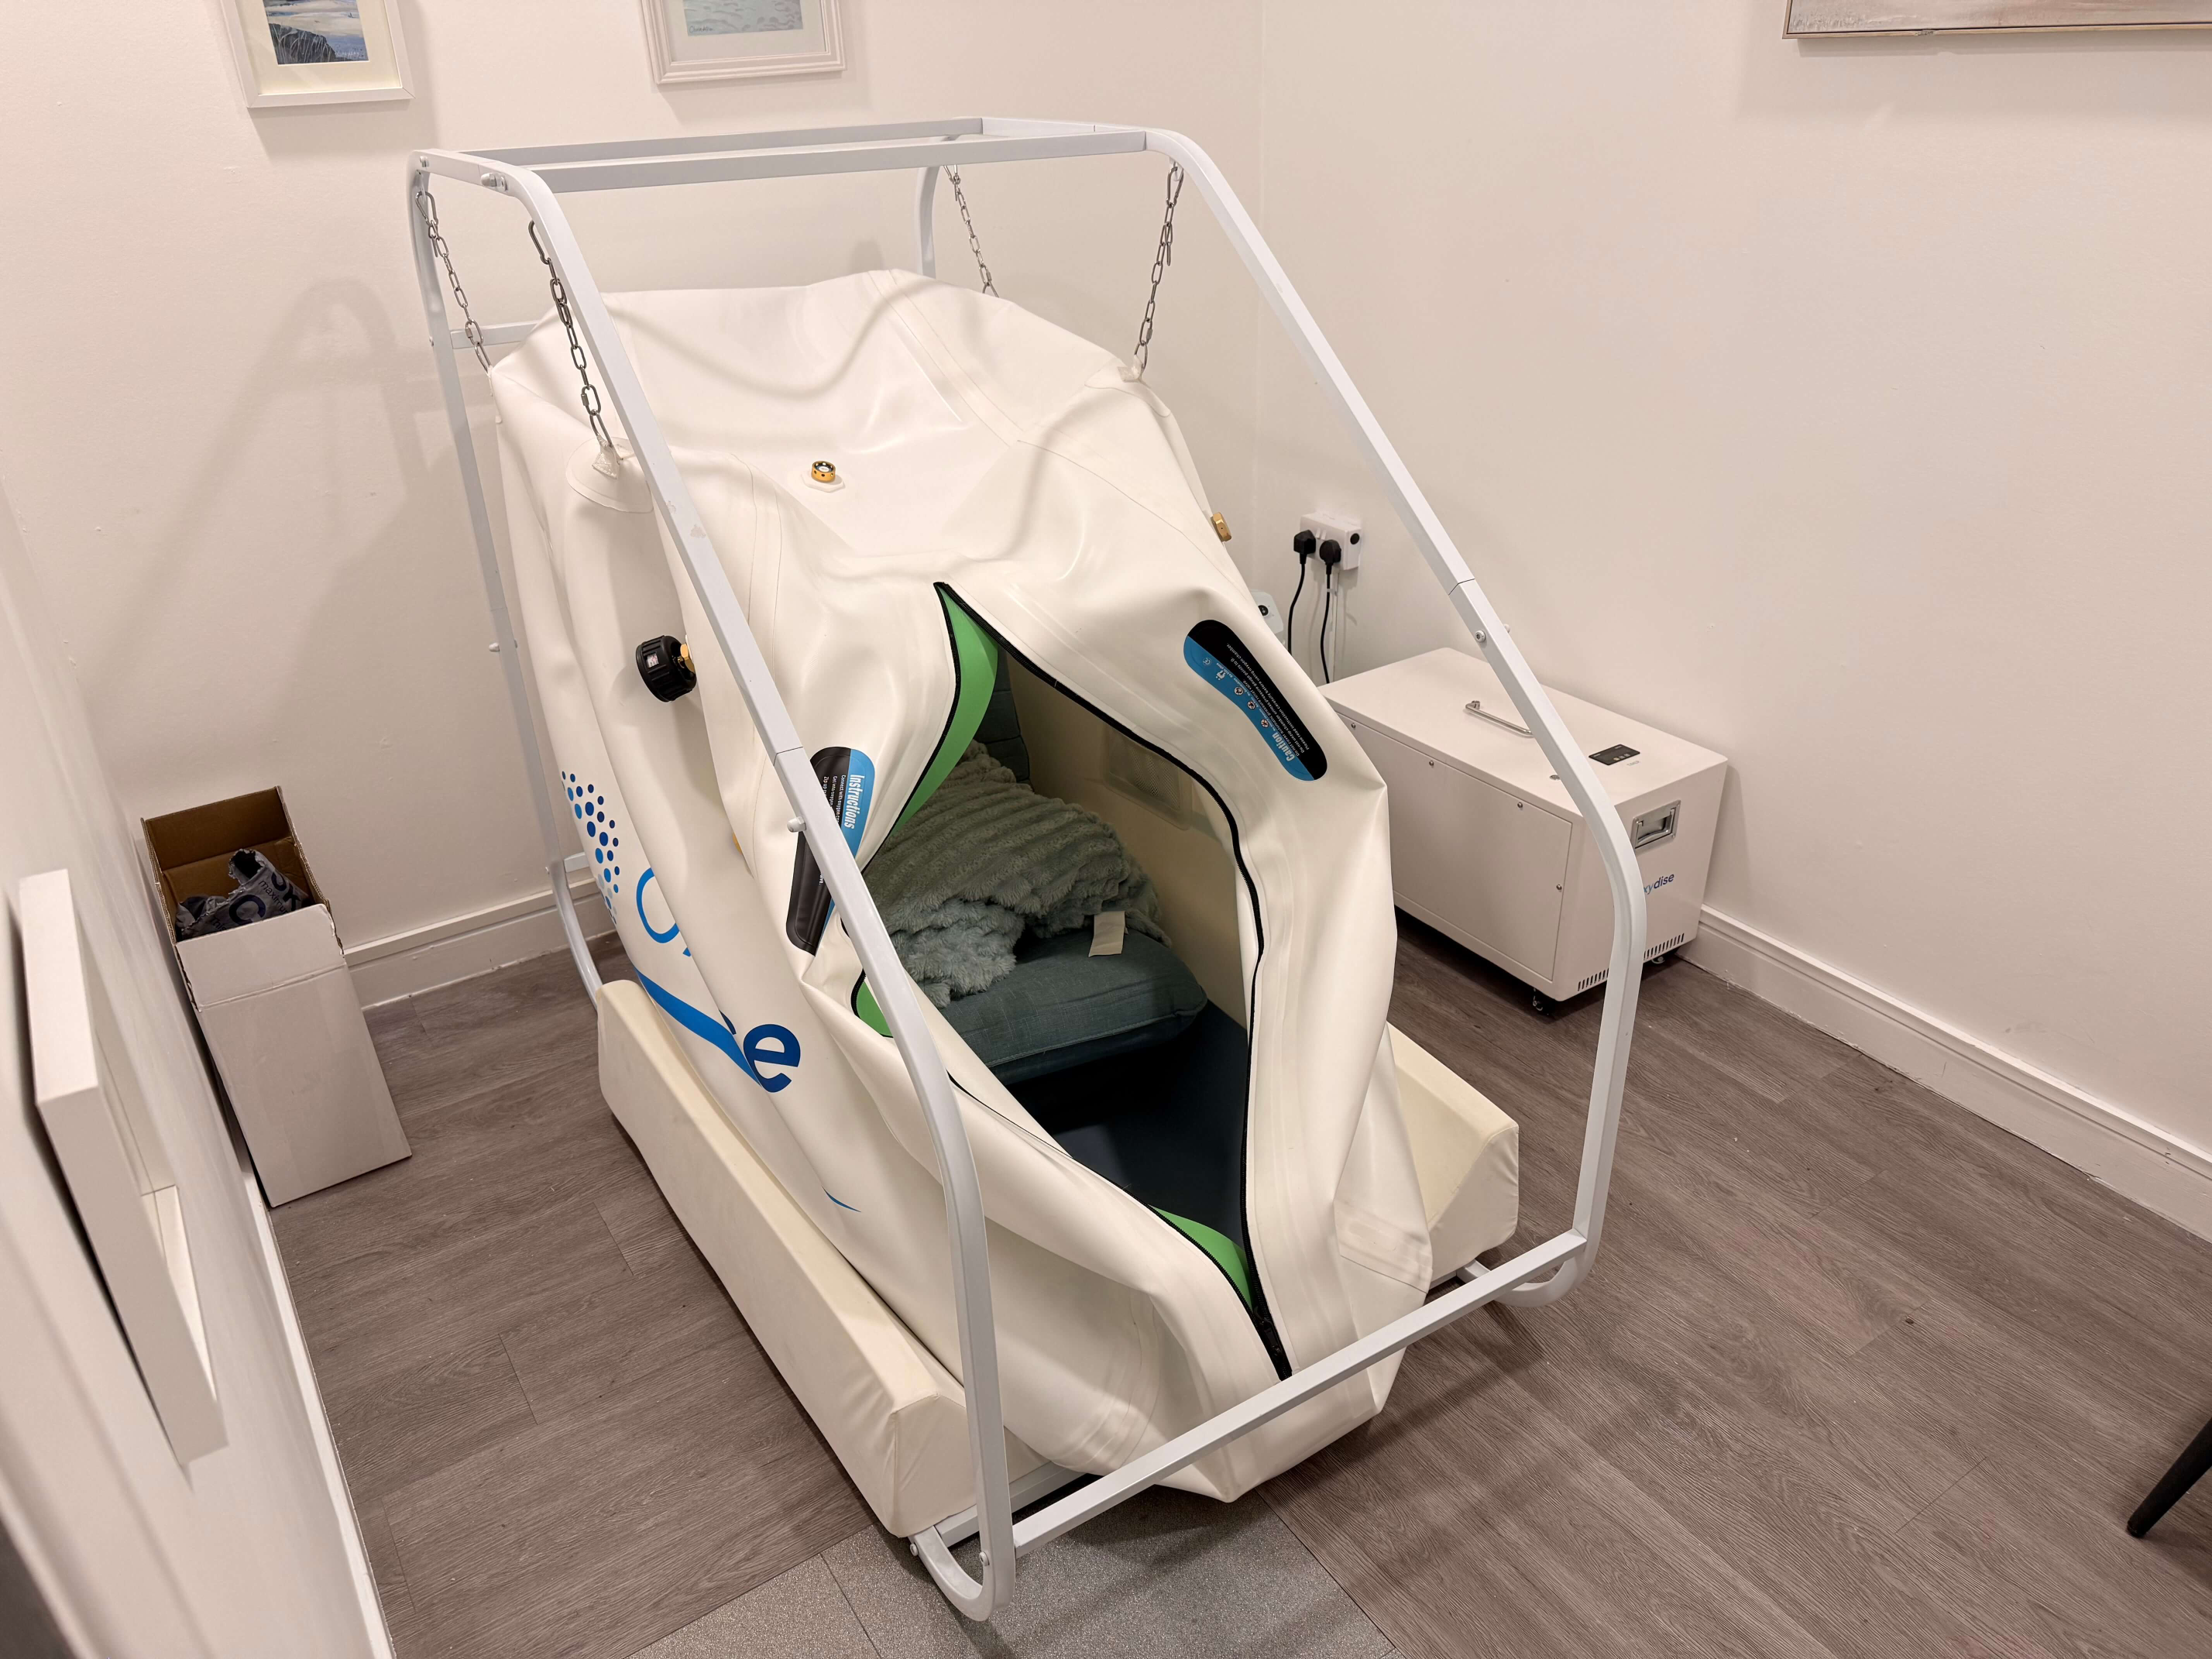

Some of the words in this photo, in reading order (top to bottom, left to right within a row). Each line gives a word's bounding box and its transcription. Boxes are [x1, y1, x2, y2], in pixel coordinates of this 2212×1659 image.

[1238, 665, 1248, 675] points
[1251, 671, 1259, 681] using
[1255, 687, 1269, 702] pressure
[1258, 700, 1271, 716] pressure
[1276, 715, 1289, 730] chamber
[1273, 732, 1295, 761] Caution
[1300, 737, 1309, 750] Please
[844, 774, 864, 830] Instructions
[1643, 874, 1674, 895] xydise
